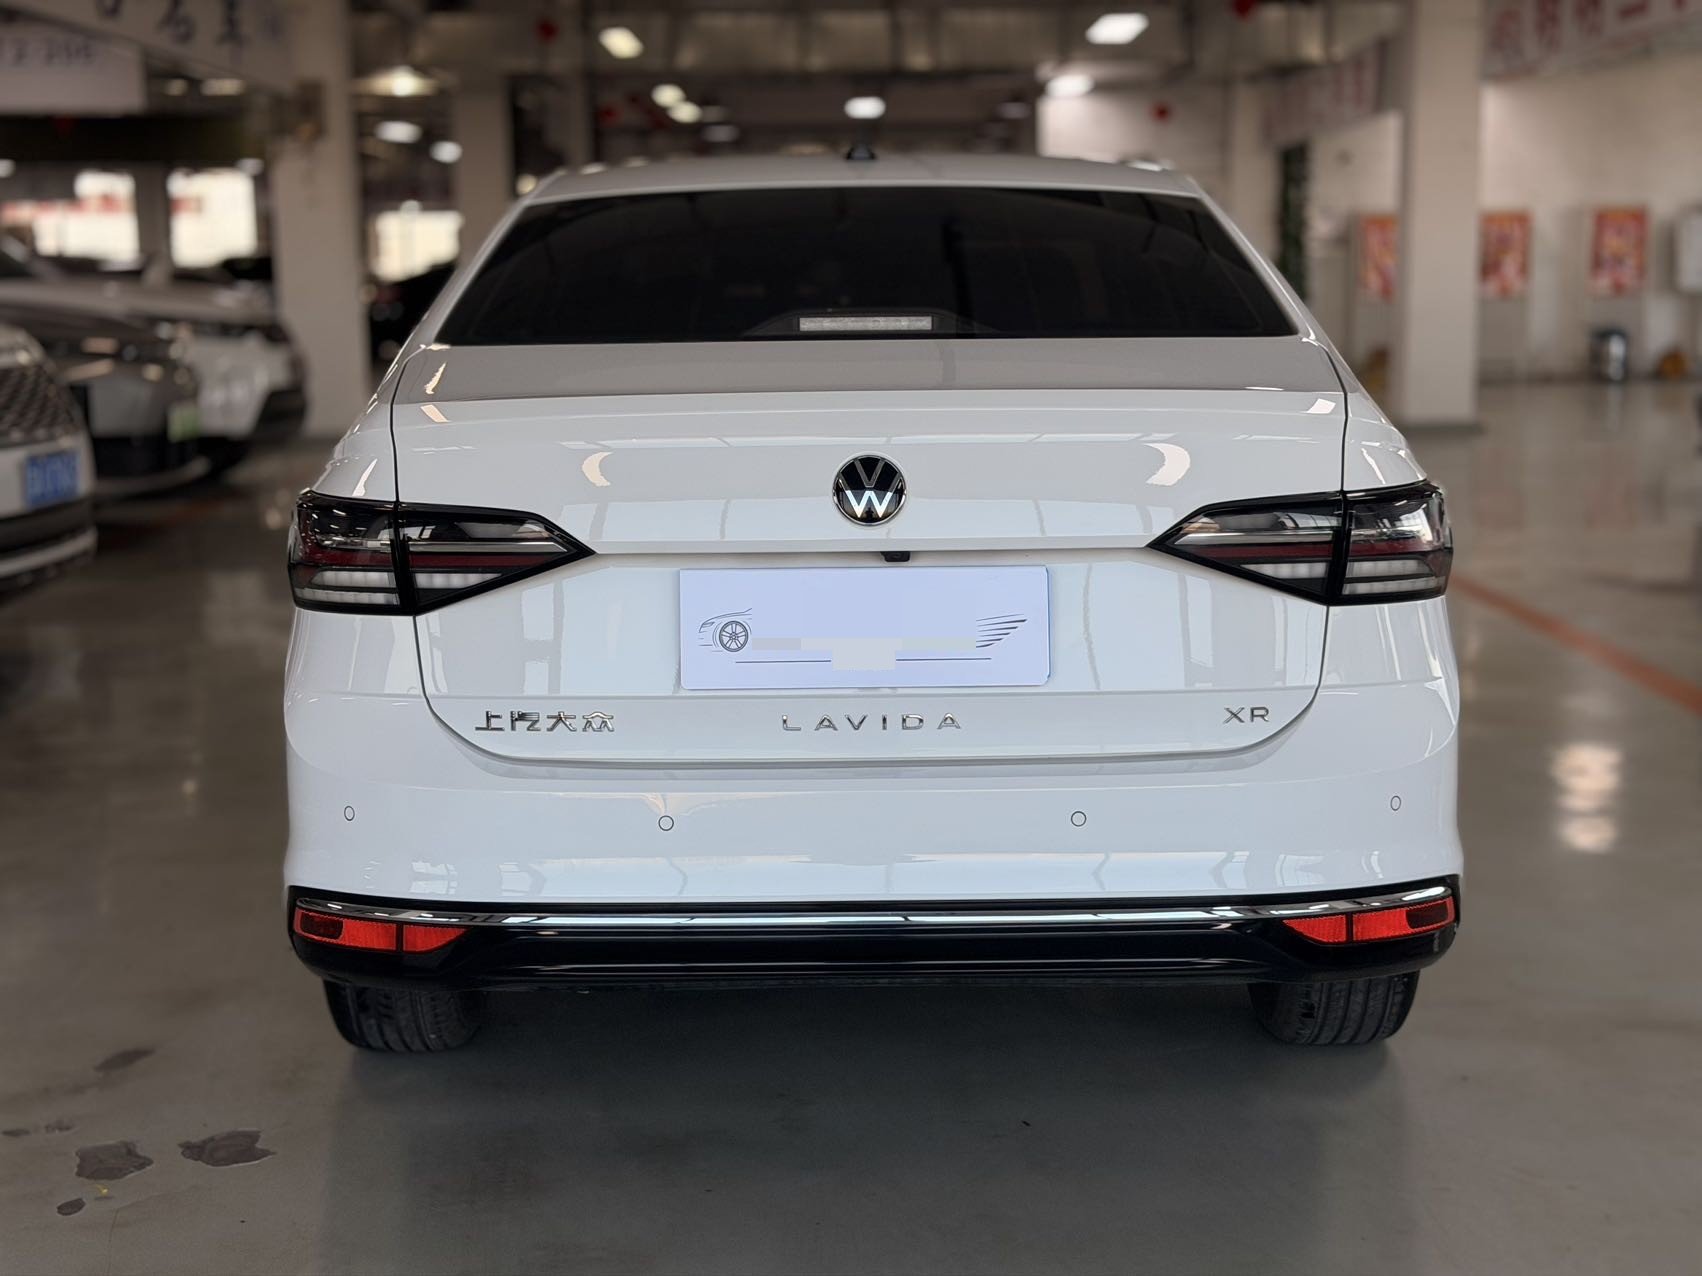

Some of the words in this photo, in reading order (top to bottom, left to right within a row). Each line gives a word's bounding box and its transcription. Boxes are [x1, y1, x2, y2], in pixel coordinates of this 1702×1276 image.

[475, 710, 615, 732] 上汽大众
[782, 712, 961, 731] LAVIDA
[1223, 706, 1270, 724] XR
